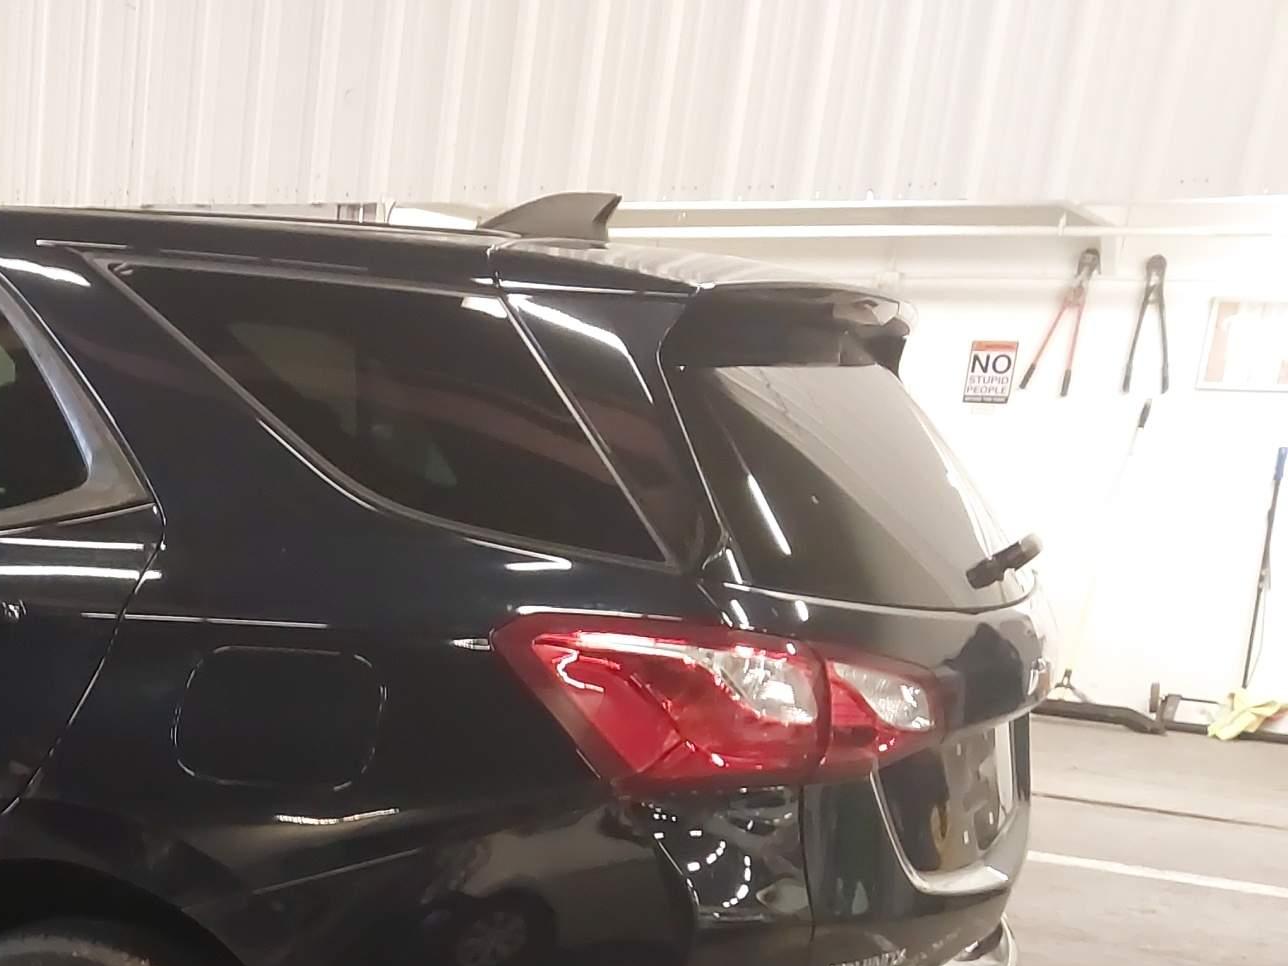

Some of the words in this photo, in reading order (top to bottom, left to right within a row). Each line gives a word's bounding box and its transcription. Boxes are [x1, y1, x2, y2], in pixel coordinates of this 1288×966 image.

[971, 353, 1012, 374] NO
[969, 375, 1009, 385] STUPID
[966, 385, 1007, 395] PEOPLE
